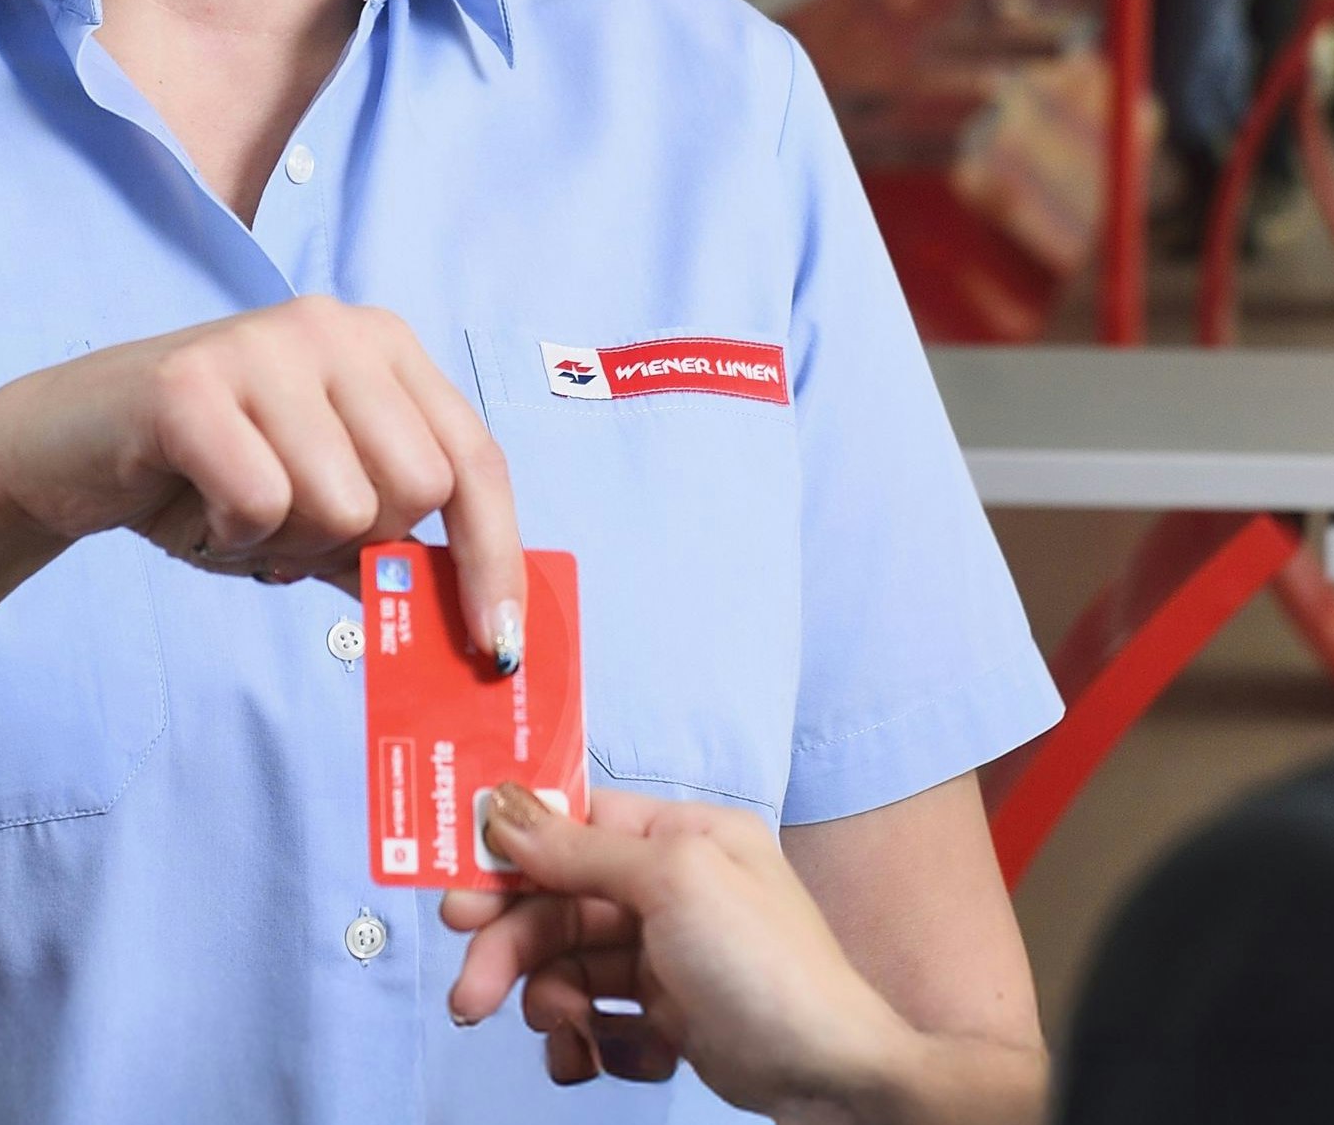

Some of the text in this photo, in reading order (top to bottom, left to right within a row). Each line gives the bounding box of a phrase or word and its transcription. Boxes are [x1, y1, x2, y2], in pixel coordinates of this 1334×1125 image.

[615, 357, 780, 384] WIENER LINIEN
[430, 741, 458, 876] Jahreskarte
